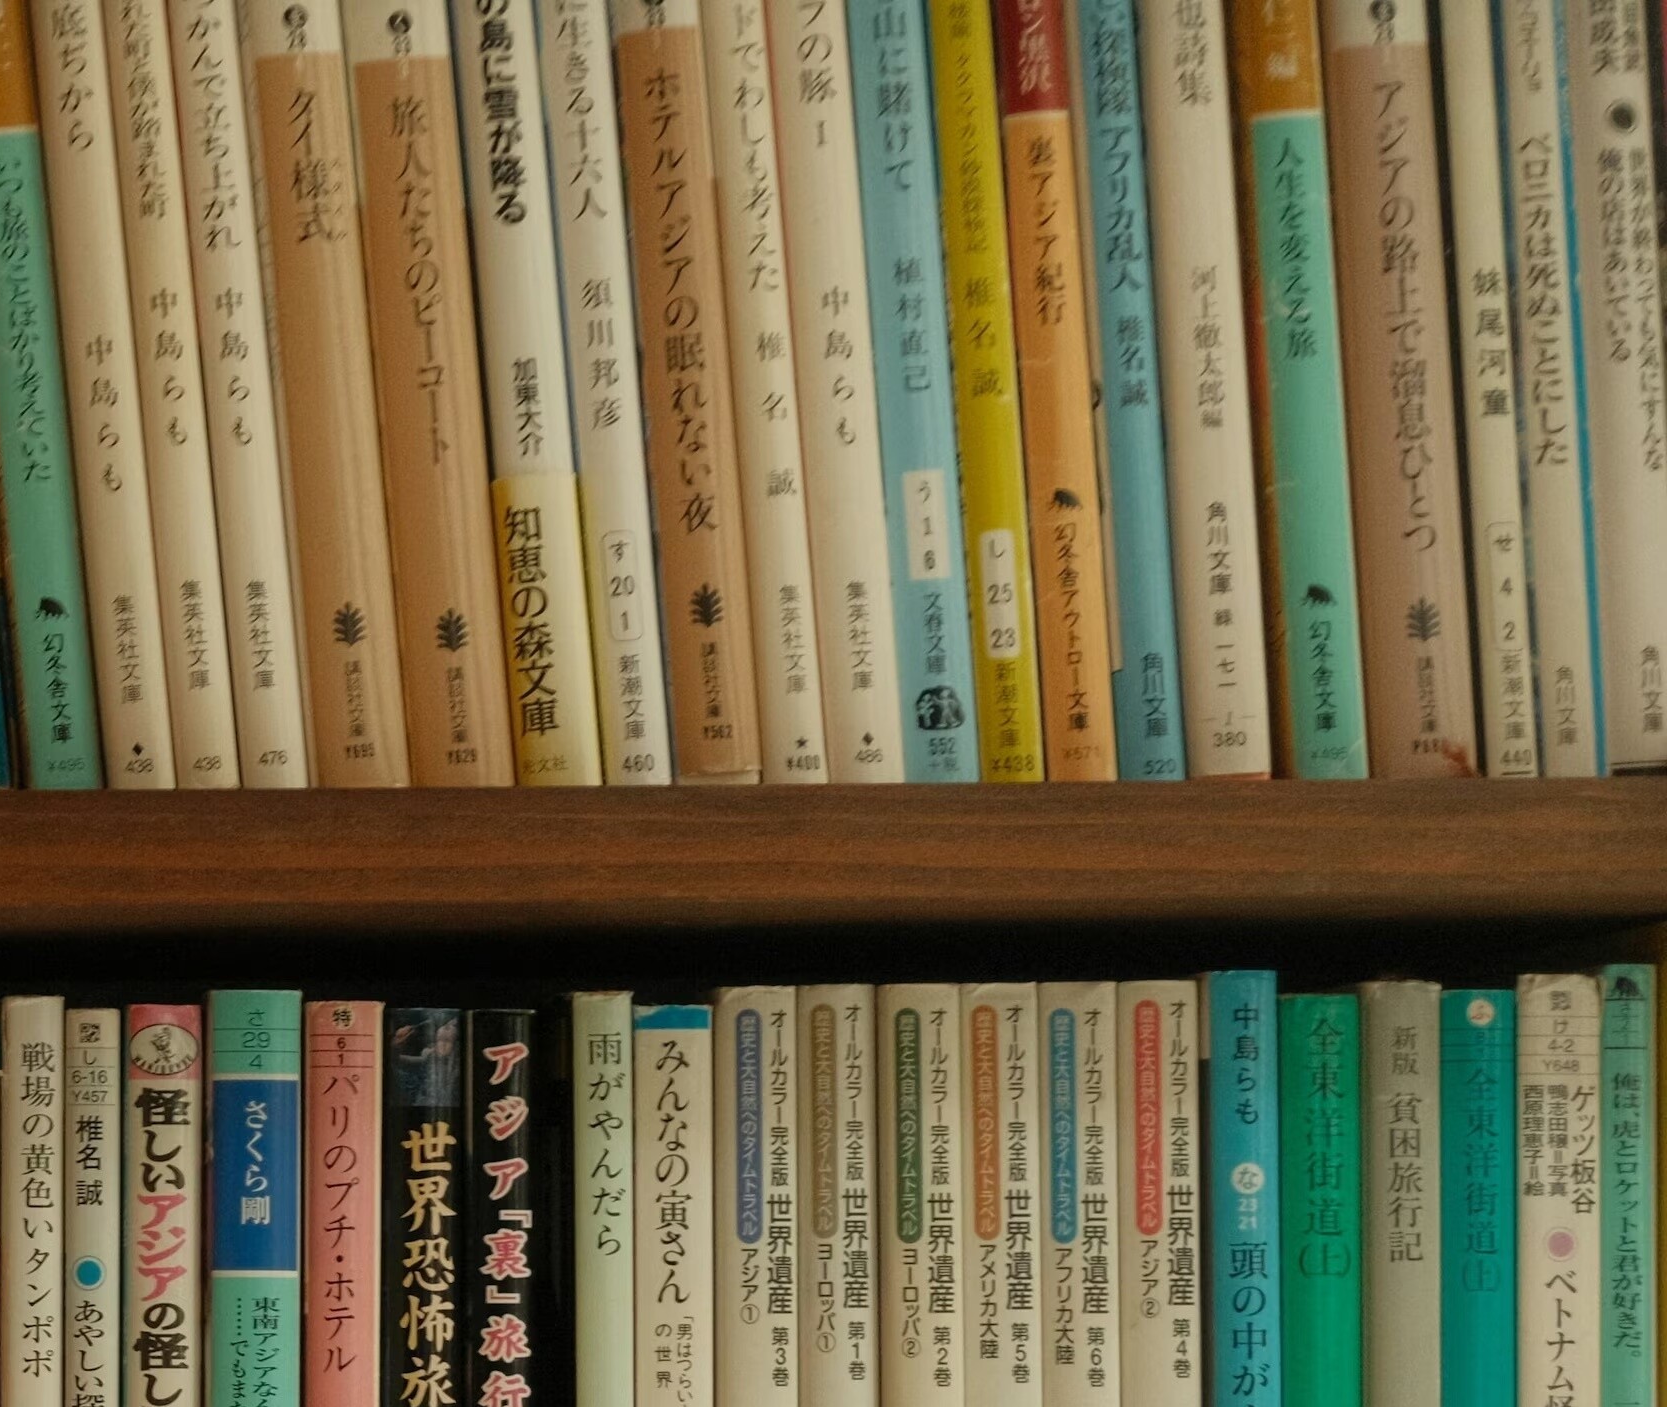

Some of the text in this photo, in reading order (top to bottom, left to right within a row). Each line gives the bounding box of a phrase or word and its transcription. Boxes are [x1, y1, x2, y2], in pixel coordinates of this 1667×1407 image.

[579, 278, 626, 433] 須川邦彦
[643, 65, 721, 536] ホテルアジアの眠れない夜
[892, 255, 932, 394] 植村直己
[1272, 136, 1319, 362] 人生を変える旅
[1370, 78, 1441, 554] アジアの路上で溜息ひとつ
[1516, 131, 1570, 468] ベロニカは死ぬことにした
[149, 287, 190, 447] 中島らも
[502, 504, 562, 739] 知恵の森文庫
[1204, 501, 1232, 596] 角川文庫
[20, 1042, 57, 1380] 戦場の黄色いタンポポ
[321, 1073, 362, 1374] パリのプチ・ホテル
[586, 1030, 628, 1260] 雨がやんだら
[653, 1039, 693, 1306] みんなの寅さん
[927, 1197, 956, 1316] 世界遺産
[1386, 1090, 1425, 1265] 貧困旅行記
[1569, 1084, 1599, 1216] ゲッツ板谷
